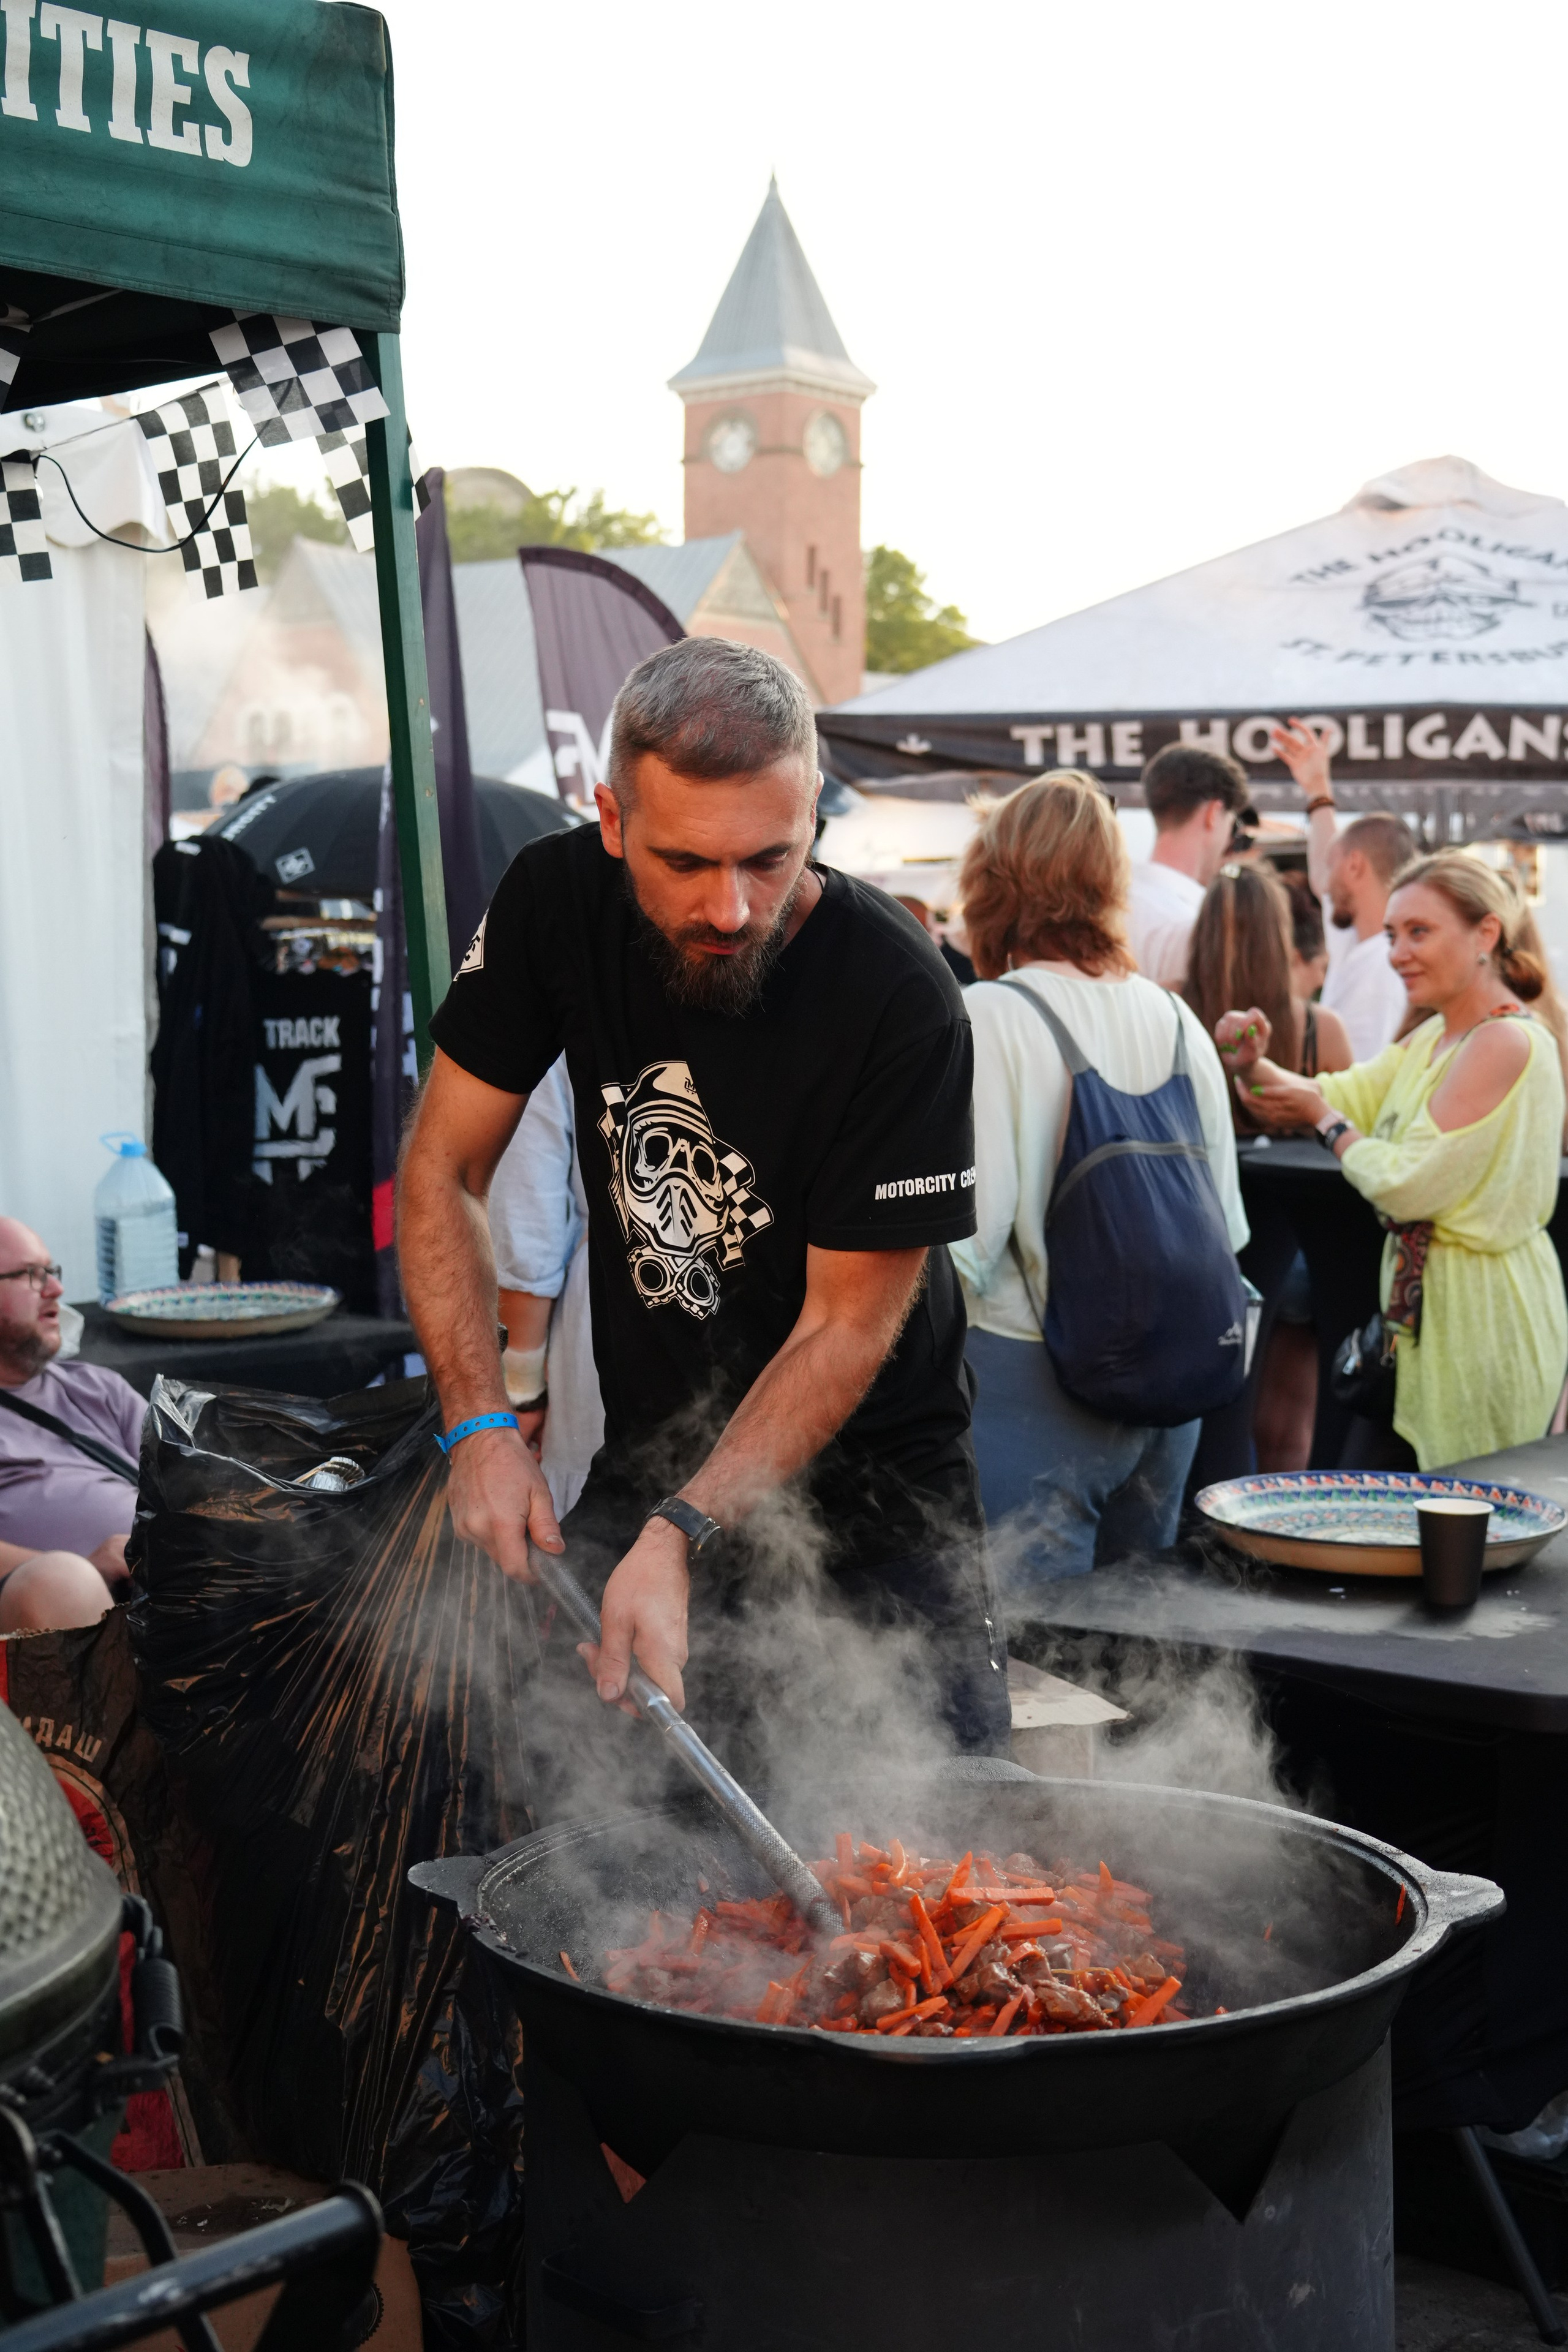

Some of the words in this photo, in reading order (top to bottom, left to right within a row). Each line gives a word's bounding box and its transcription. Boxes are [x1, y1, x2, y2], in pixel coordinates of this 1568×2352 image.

[0, 0, 252, 167] ITIES
[1010, 722, 1145, 767] THE
[1178, 712, 1568, 763] HOOLIGAN
[263, 1016, 341, 1049] TRACK
[875, 1173, 956, 1200] MOTORCITY
